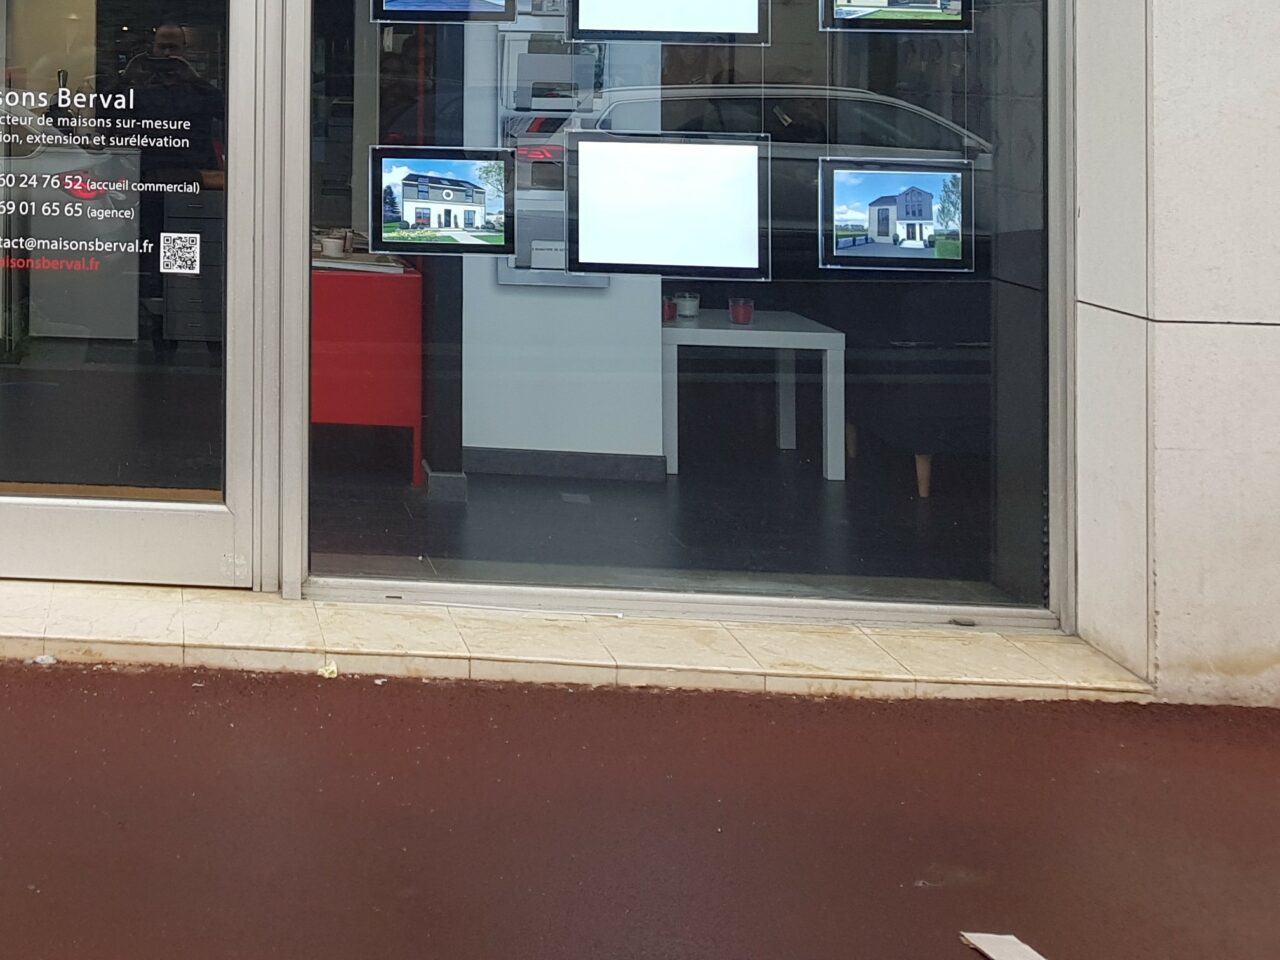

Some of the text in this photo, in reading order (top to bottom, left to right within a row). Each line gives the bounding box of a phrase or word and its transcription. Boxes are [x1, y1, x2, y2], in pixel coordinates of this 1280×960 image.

[58, 88, 135, 110] Berval
[37, 113, 54, 127] de
[57, 115, 112, 128] maisons
[115, 117, 191, 131] sur-mesure
[26, 132, 90, 146] extension
[93, 135, 108, 147] et
[109, 134, 190, 149] surélévation
[20, 174, 37, 188] 24
[42, 174, 61, 189] 76
[64, 175, 83, 190] 52
[86, 178, 129, 192] (accueil
[131, 180, 200, 194] commercial)
[20, 201, 37, 215] 01
[41, 201, 60, 216] 65
[64, 202, 83, 217] 65
[86, 206, 135, 220] (agence)
